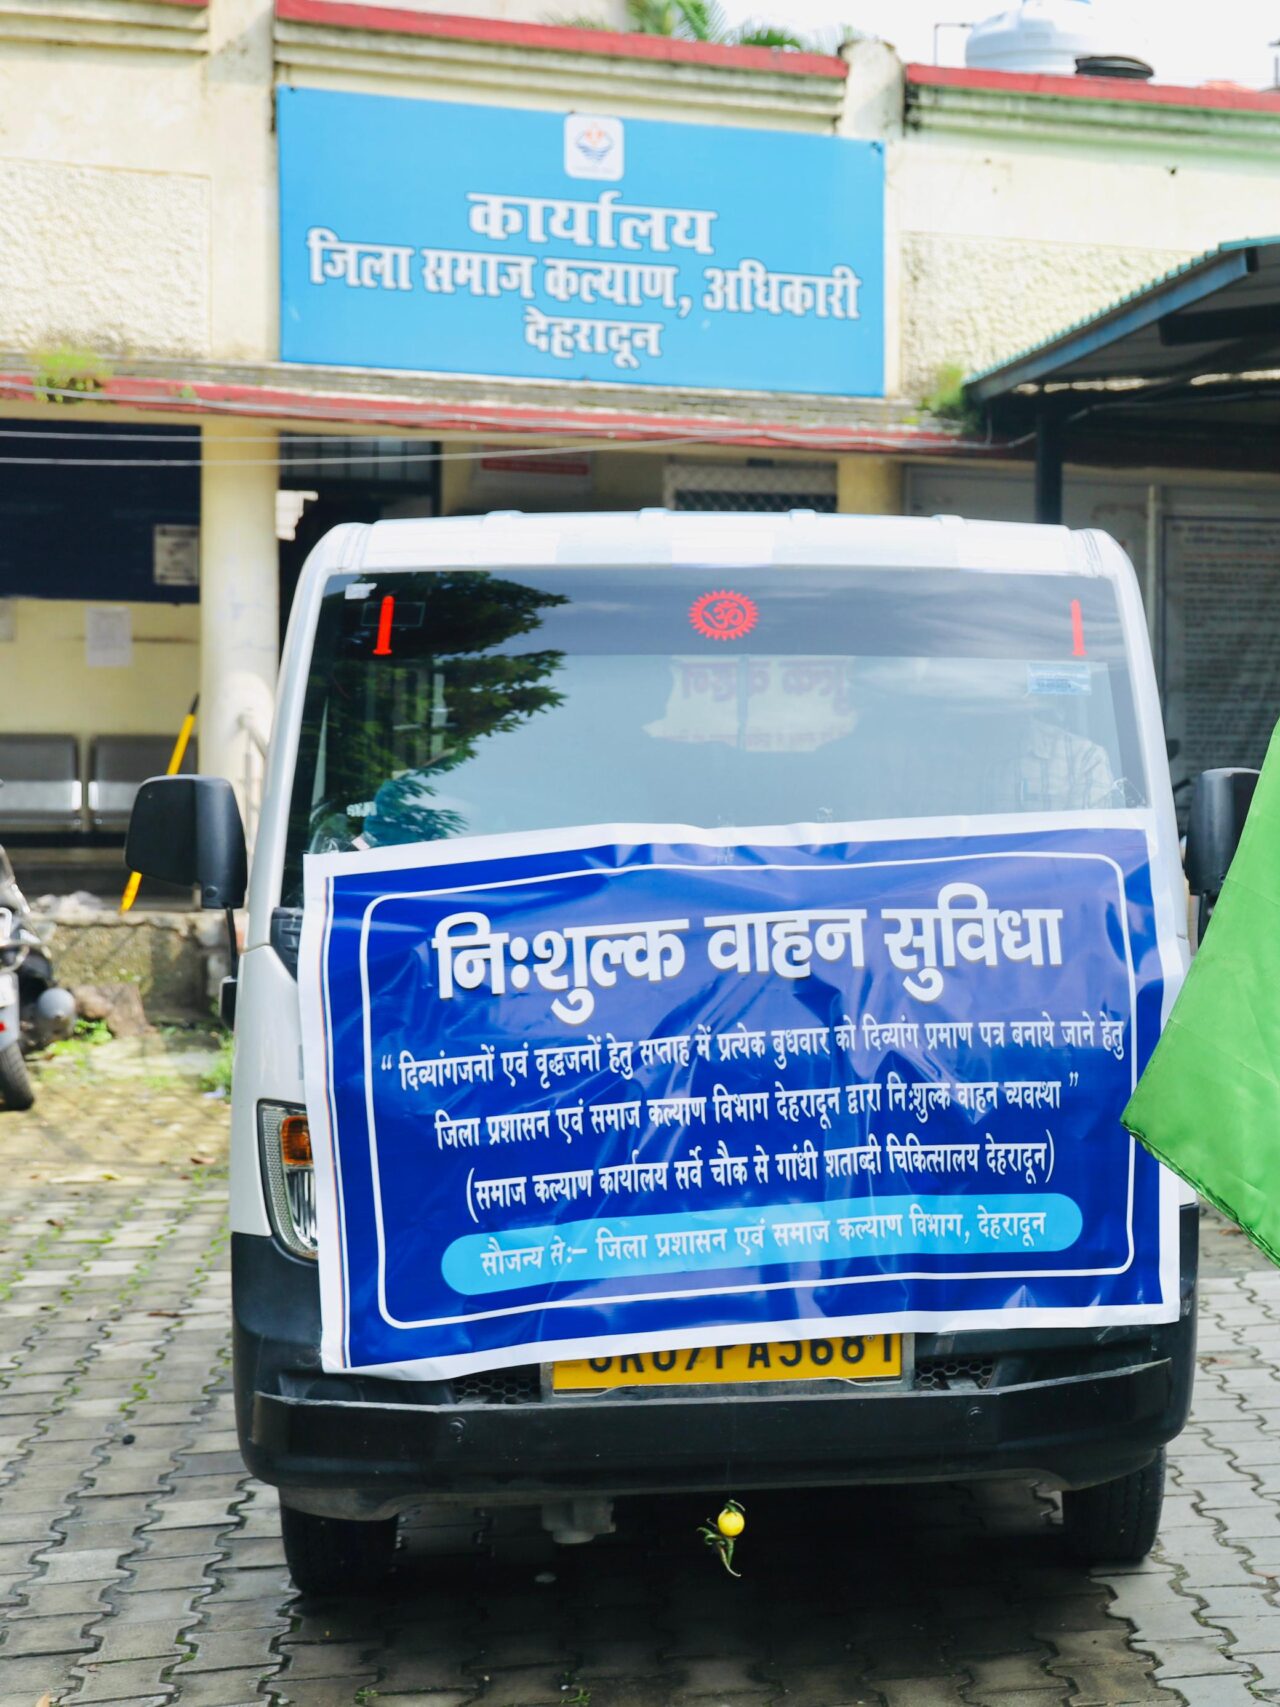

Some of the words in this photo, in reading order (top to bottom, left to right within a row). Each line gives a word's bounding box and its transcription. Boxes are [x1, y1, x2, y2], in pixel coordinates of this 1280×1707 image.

[467, 190, 718, 254] कार्यालय
[306, 227, 413, 291] जिला
[421, 246, 537, 299] समाज
[543, 257, 694, 319] कल्याण,
[703, 258, 862, 320] अधिकारी
[523, 305, 664, 368] देहरादून
[704, 908, 867, 979] वाहन
[881, 882, 1063, 1001] सुविधा
[399, 1044, 495, 1091] दिव्यांगजनों
[501, 1042, 529, 1087] एवं
[535, 1034, 602, 1089] वृद्धजनों
[606, 1032, 634, 1079] हेतु
[638, 1035, 692, 1067] सप्ताह
[695, 1023, 712, 1062] में
[717, 1022, 766, 1061] प्रत्येक
[772, 1026, 831, 1069] बुधवार
[835, 1013, 857, 1052] को
[862, 1014, 919, 1050] दिव्यांग
[924, 1022, 973, 1050] प्रमाण
[979, 1022, 1005, 1049] पत्र
[1010, 1011, 1057, 1048] बनाये
[1061, 1011, 1097, 1047] जाने
[1100, 1011, 1125, 1060] हेतु
[434, 1109, 481, 1150] जिला
[486, 1110, 551, 1145] प्रशासन
[556, 1098, 584, 1143] एवं
[589, 1101, 641, 1132] समाज
[647, 1097, 707, 1126] कल्याण
[712, 1084, 769, 1121] विभाग
[775, 1081, 840, 1129] देहरादून
[846, 1084, 881, 1114] द्वारा
[955, 1082, 998, 1113] वाहन
[1004, 1081, 1061, 1109] व्यवस्था
[466, 1167, 527, 1223] (समाज
[532, 1170, 593, 1202] कल्याण
[599, 1150, 669, 1195] कार्यालय
[674, 1146, 702, 1189] सर्वे
[709, 1140, 748, 1186] चौक
[753, 1145, 769, 1184] से
[775, 1139, 818, 1182] गांधी
[824, 1135, 882, 1176] शताब्दी
[886, 1133, 980, 1173] चिकित्सालय
[985, 1130, 1055, 1184] देहरादून)
[480, 1237, 544, 1277] सौजन्य
[595, 1227, 648, 1262] जिला
[655, 1228, 727, 1257] प्रशासन
[734, 1218, 765, 1256] एवं
[772, 1220, 830, 1248] समाज
[837, 1214, 903, 1241] कल्याण
[909, 1203, 970, 1245] विभाग,
[977, 1204, 1047, 1248] देहरादून
